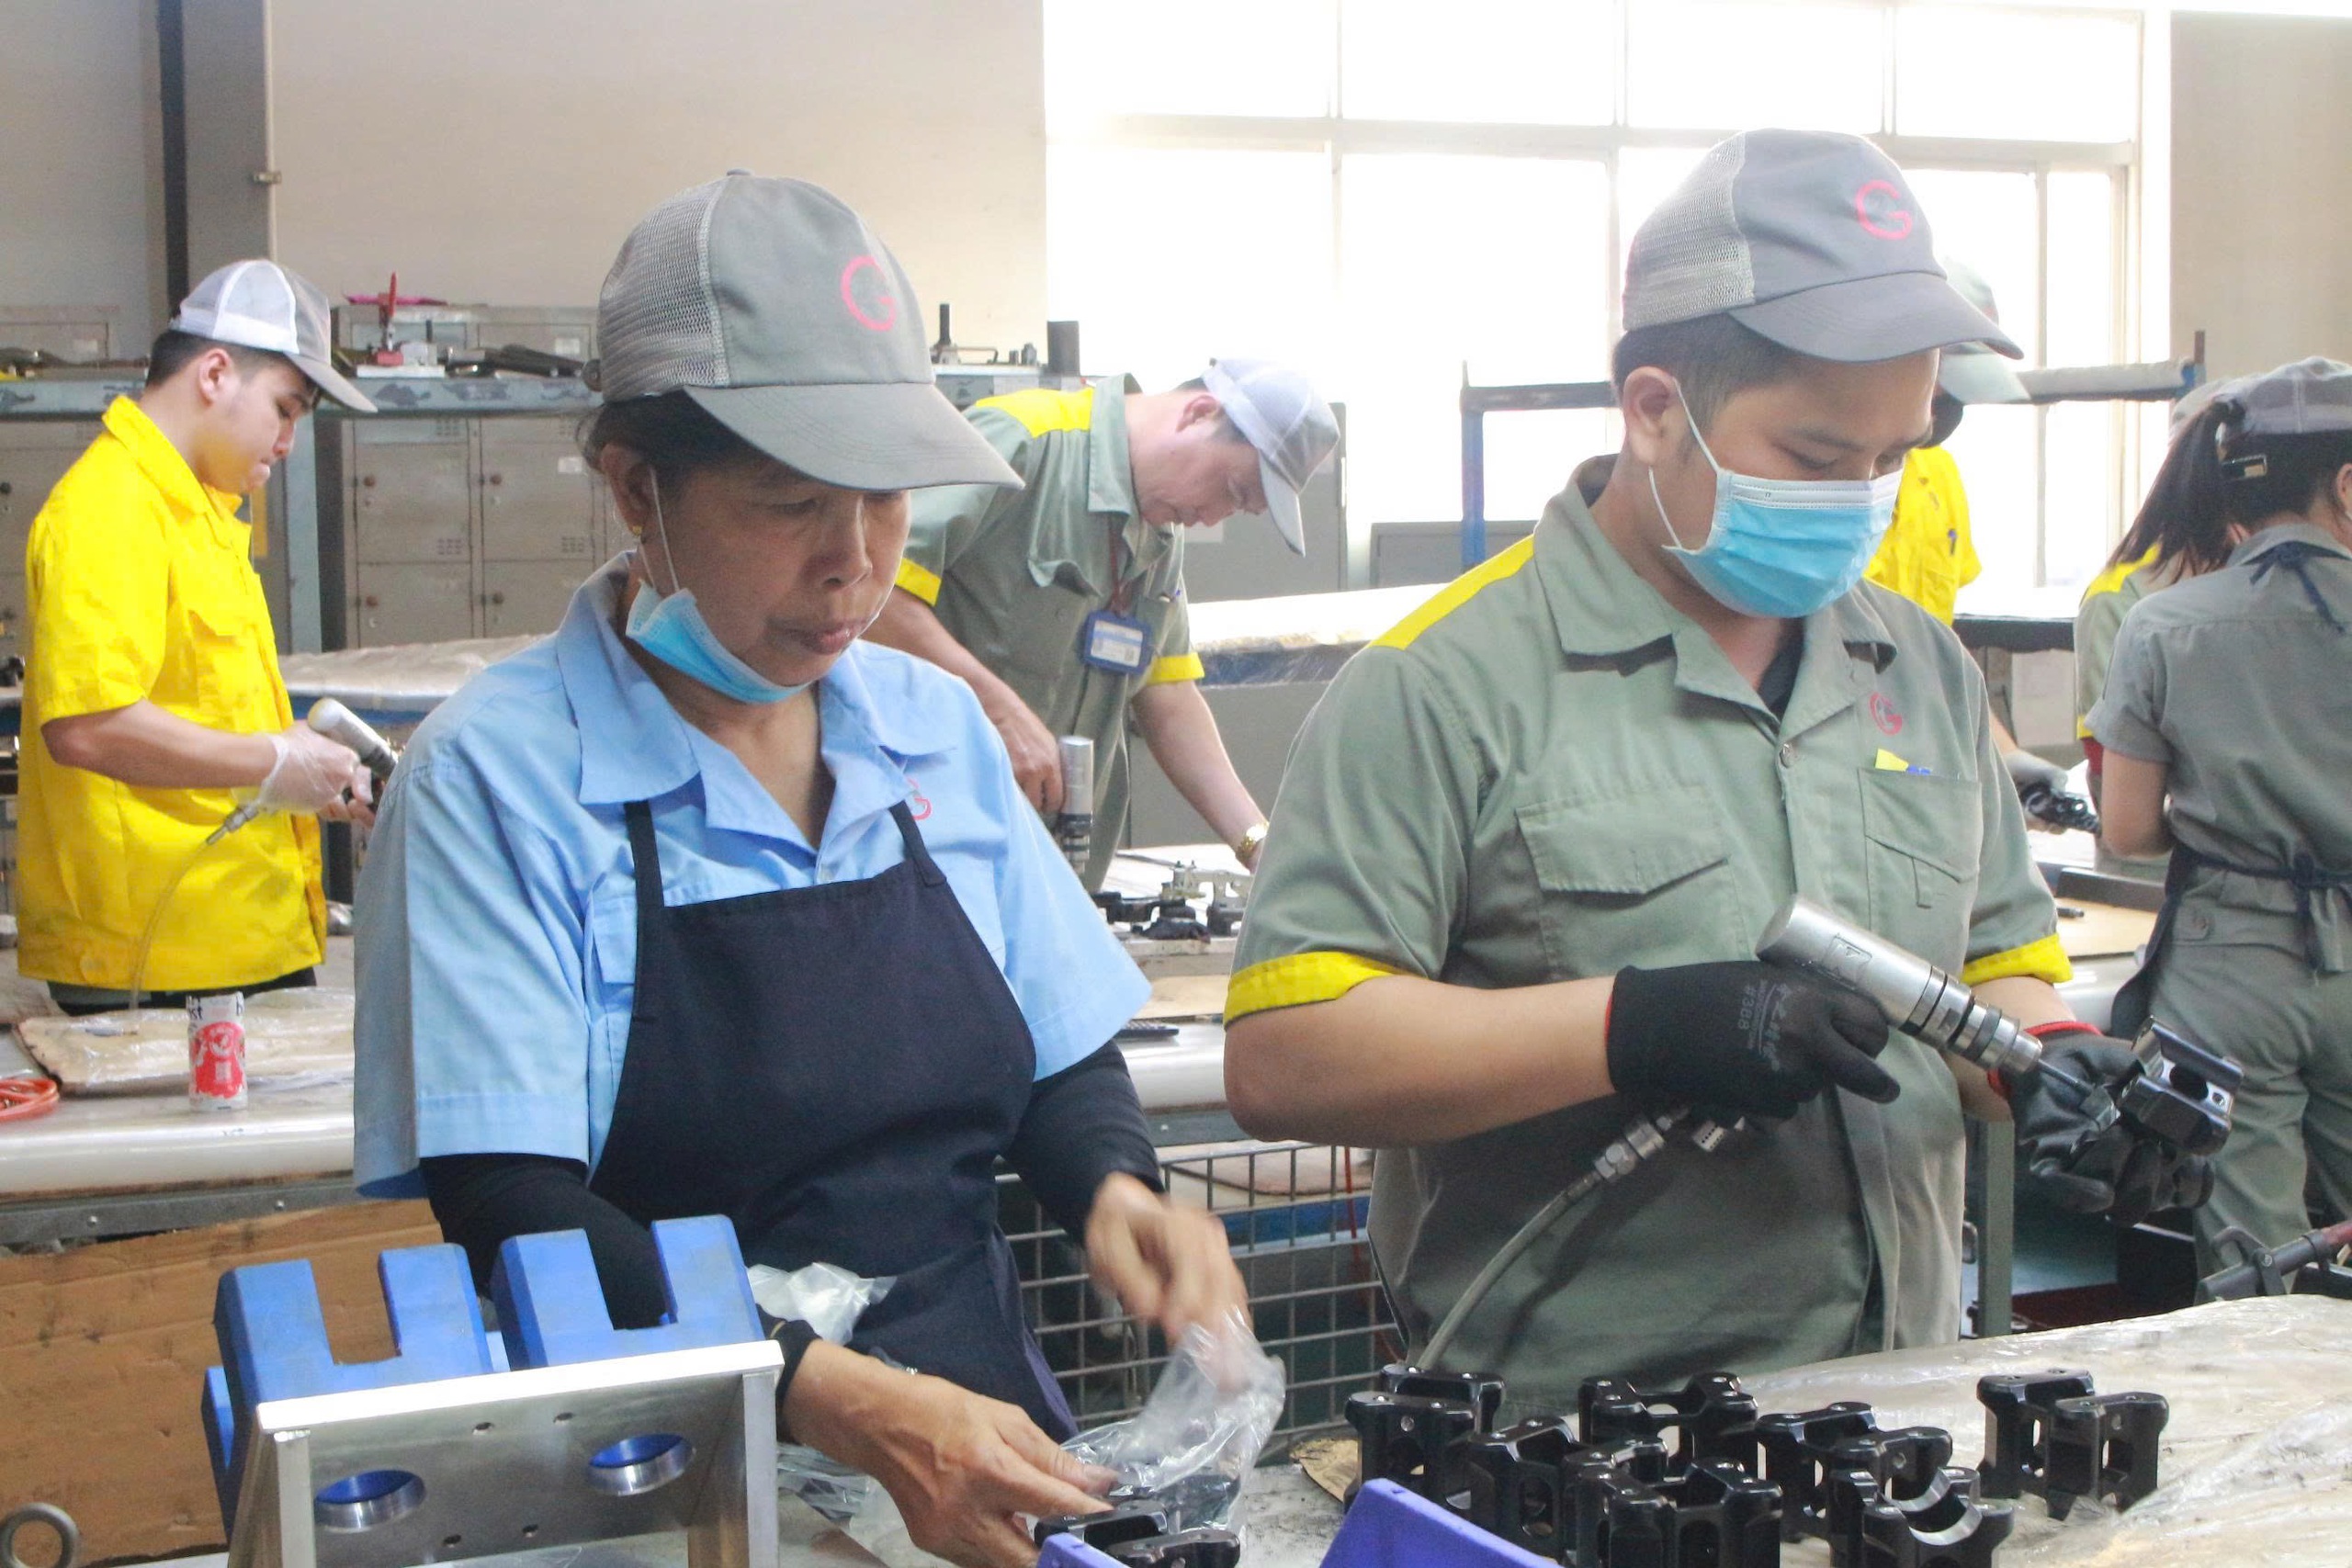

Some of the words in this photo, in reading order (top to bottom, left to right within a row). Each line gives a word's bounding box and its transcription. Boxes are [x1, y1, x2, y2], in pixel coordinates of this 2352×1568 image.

[1854, 179, 1913, 240] G
[840, 255, 897, 331] G
[1869, 692, 1903, 736] G
